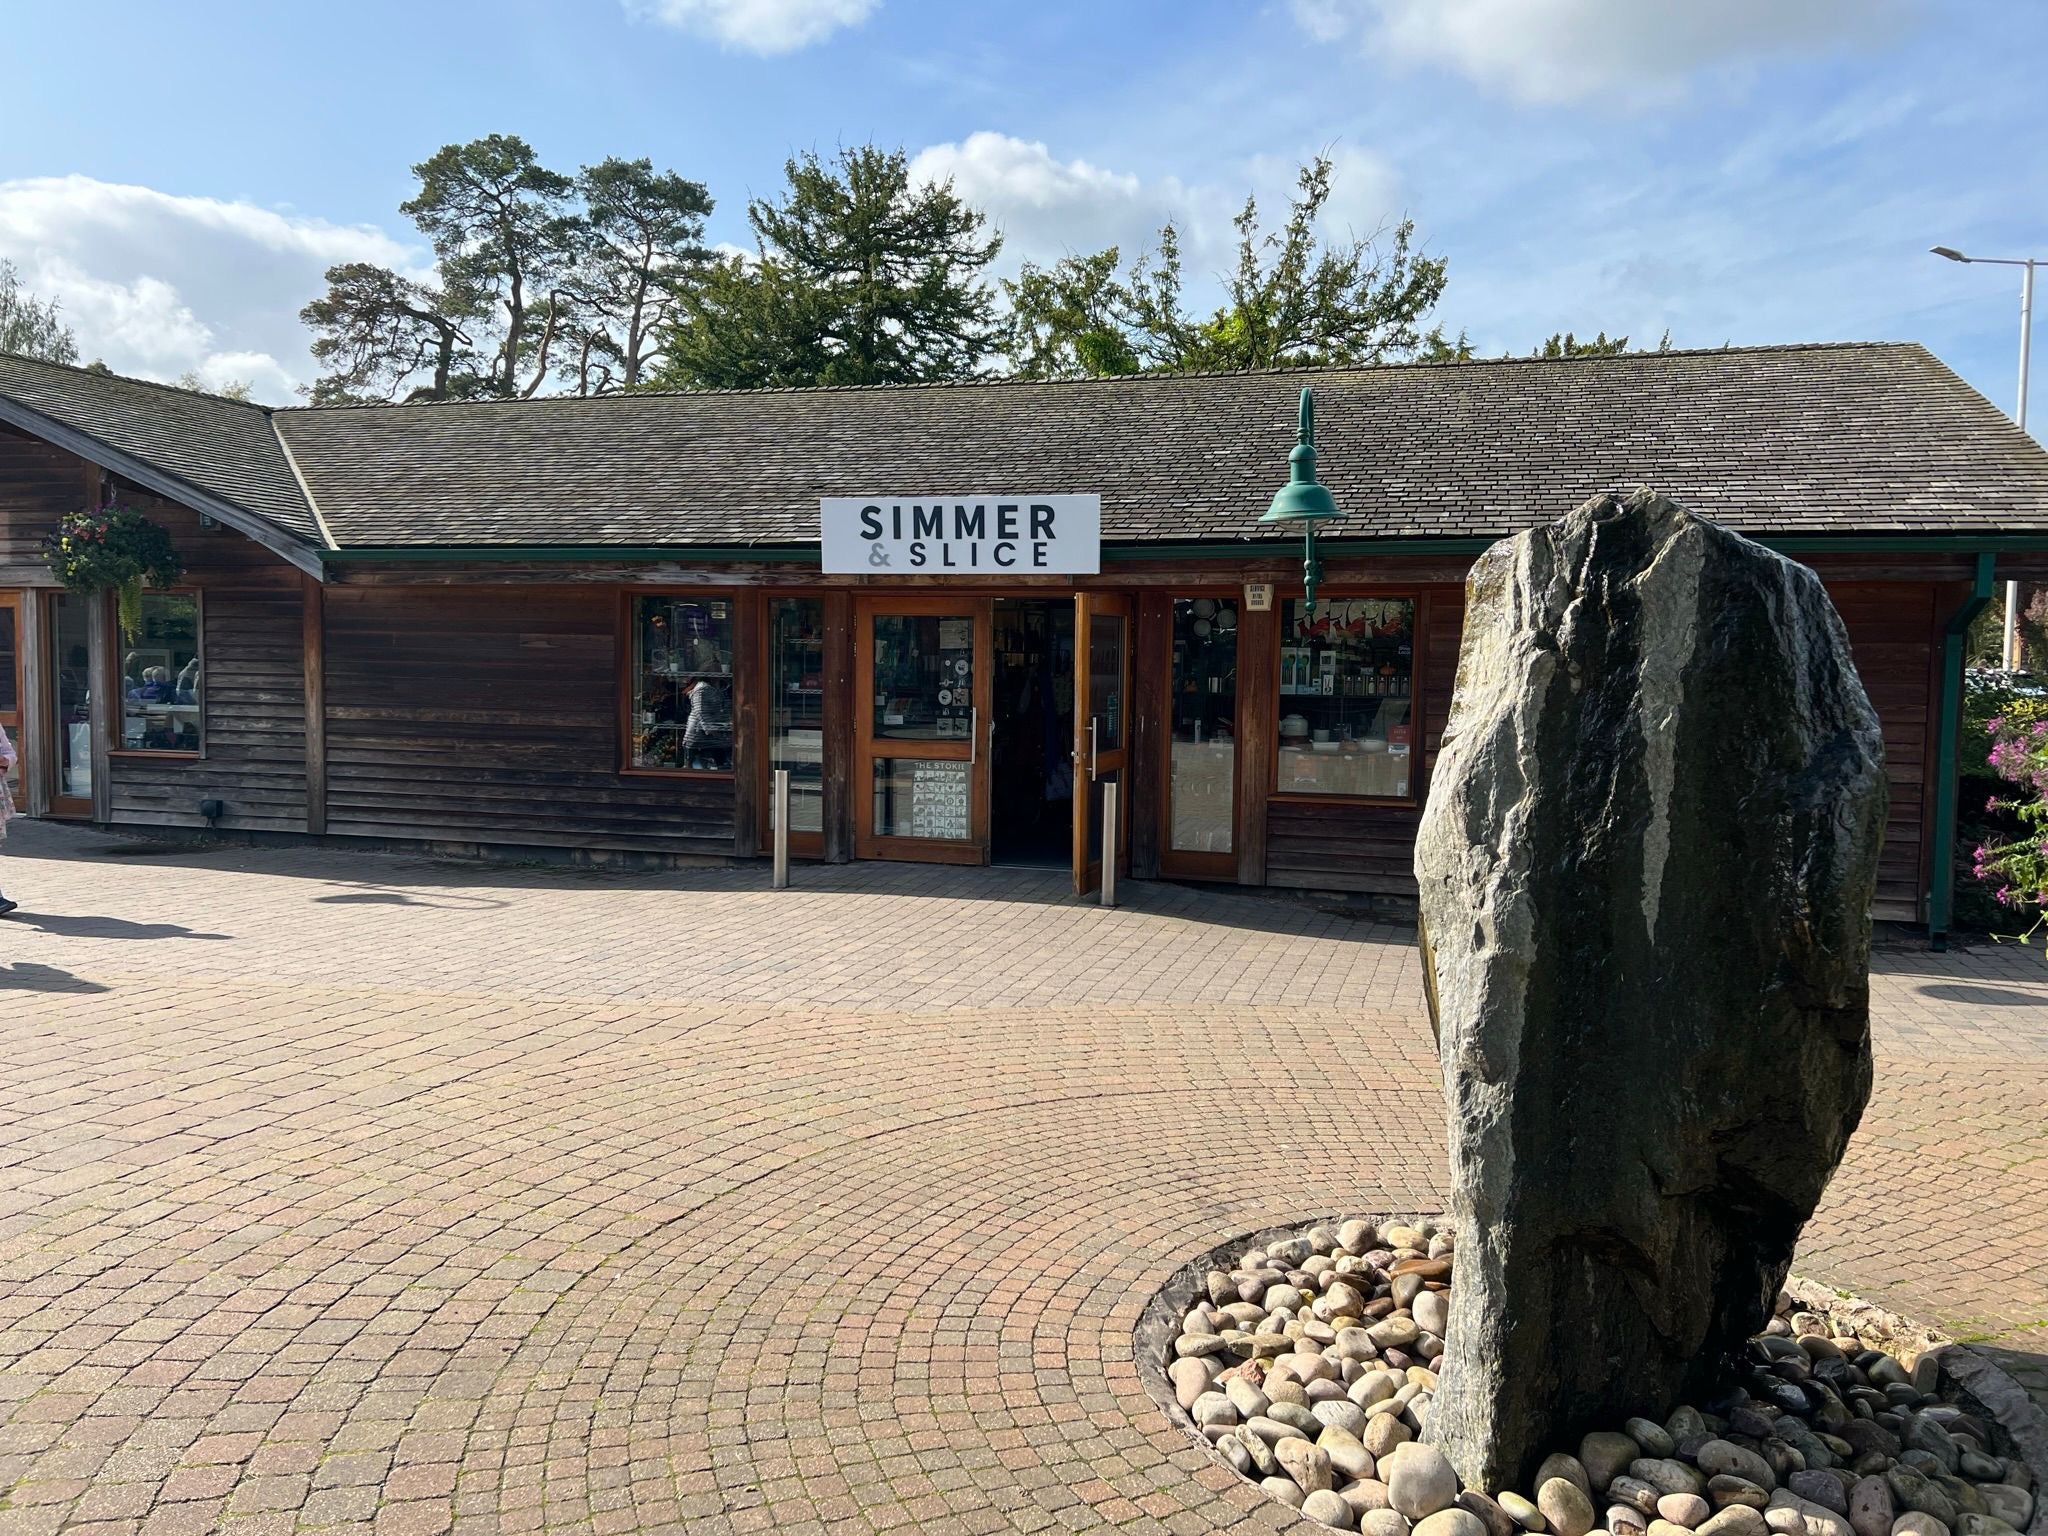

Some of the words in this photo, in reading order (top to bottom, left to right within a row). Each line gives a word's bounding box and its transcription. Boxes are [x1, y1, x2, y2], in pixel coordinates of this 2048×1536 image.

[860, 504, 1056, 540] SIMMER
[868, 542, 891, 567] &
[909, 542, 1048, 567] SLICE
